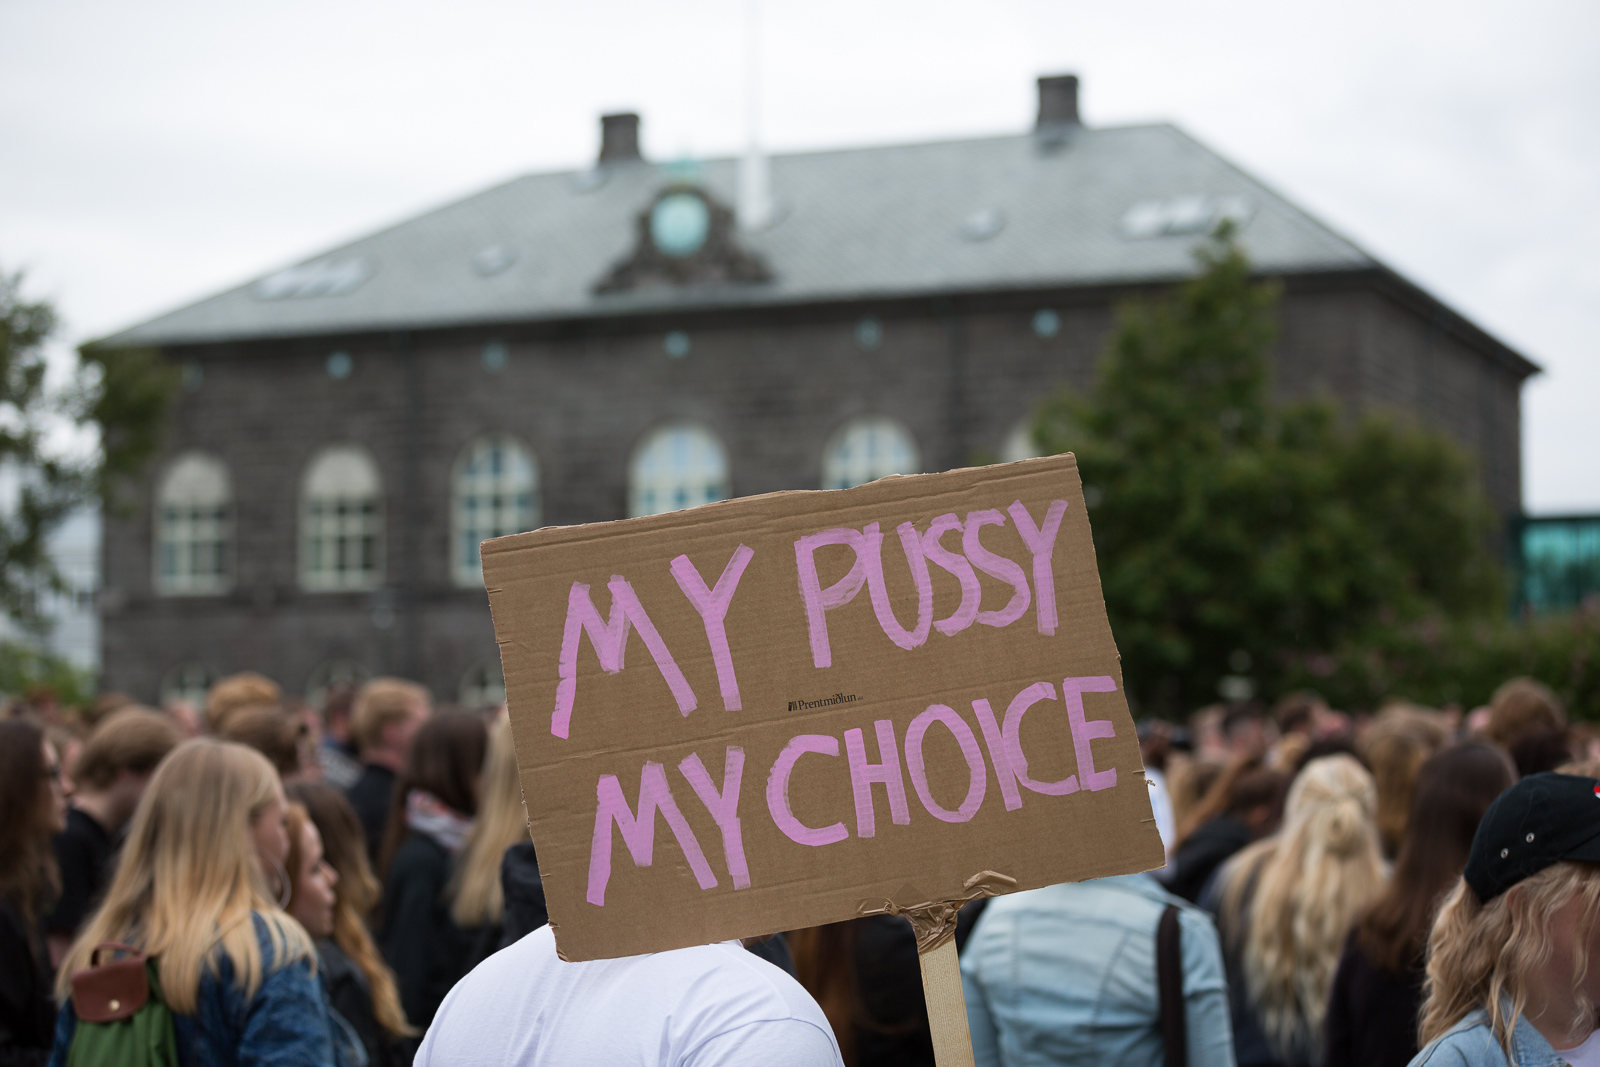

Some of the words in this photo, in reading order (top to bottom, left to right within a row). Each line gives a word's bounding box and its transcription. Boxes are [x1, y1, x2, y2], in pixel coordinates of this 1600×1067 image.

[551, 543, 755, 739] MY
[794, 499, 1069, 669] PUSSY
[798, 692, 857, 710] Prentmiðlun
[586, 745, 751, 907] MY
[765, 675, 1118, 847] CHOICE
